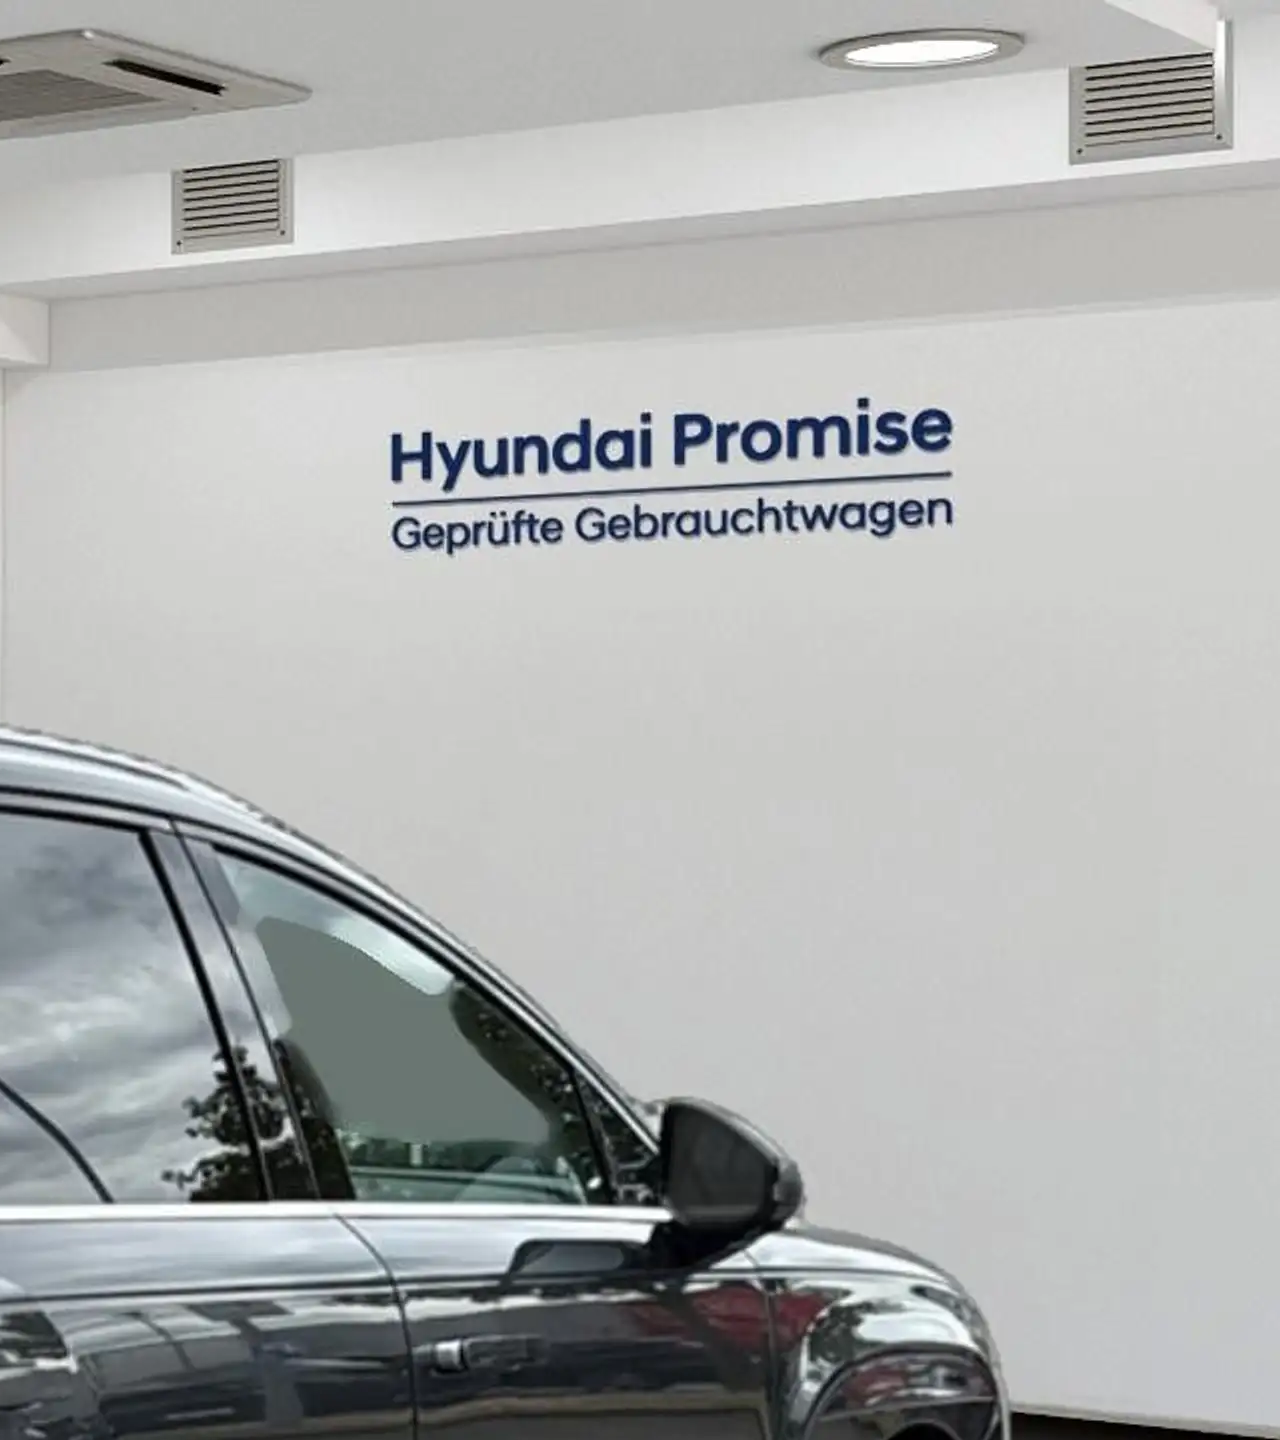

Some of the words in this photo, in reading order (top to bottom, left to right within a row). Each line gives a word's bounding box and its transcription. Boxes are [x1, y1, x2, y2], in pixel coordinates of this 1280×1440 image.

[391, 411, 653, 494] Hyundai
[673, 397, 954, 467] Promise
[391, 509, 564, 556] Geprüfte
[575, 497, 953, 543] Gebrauchtwagen
